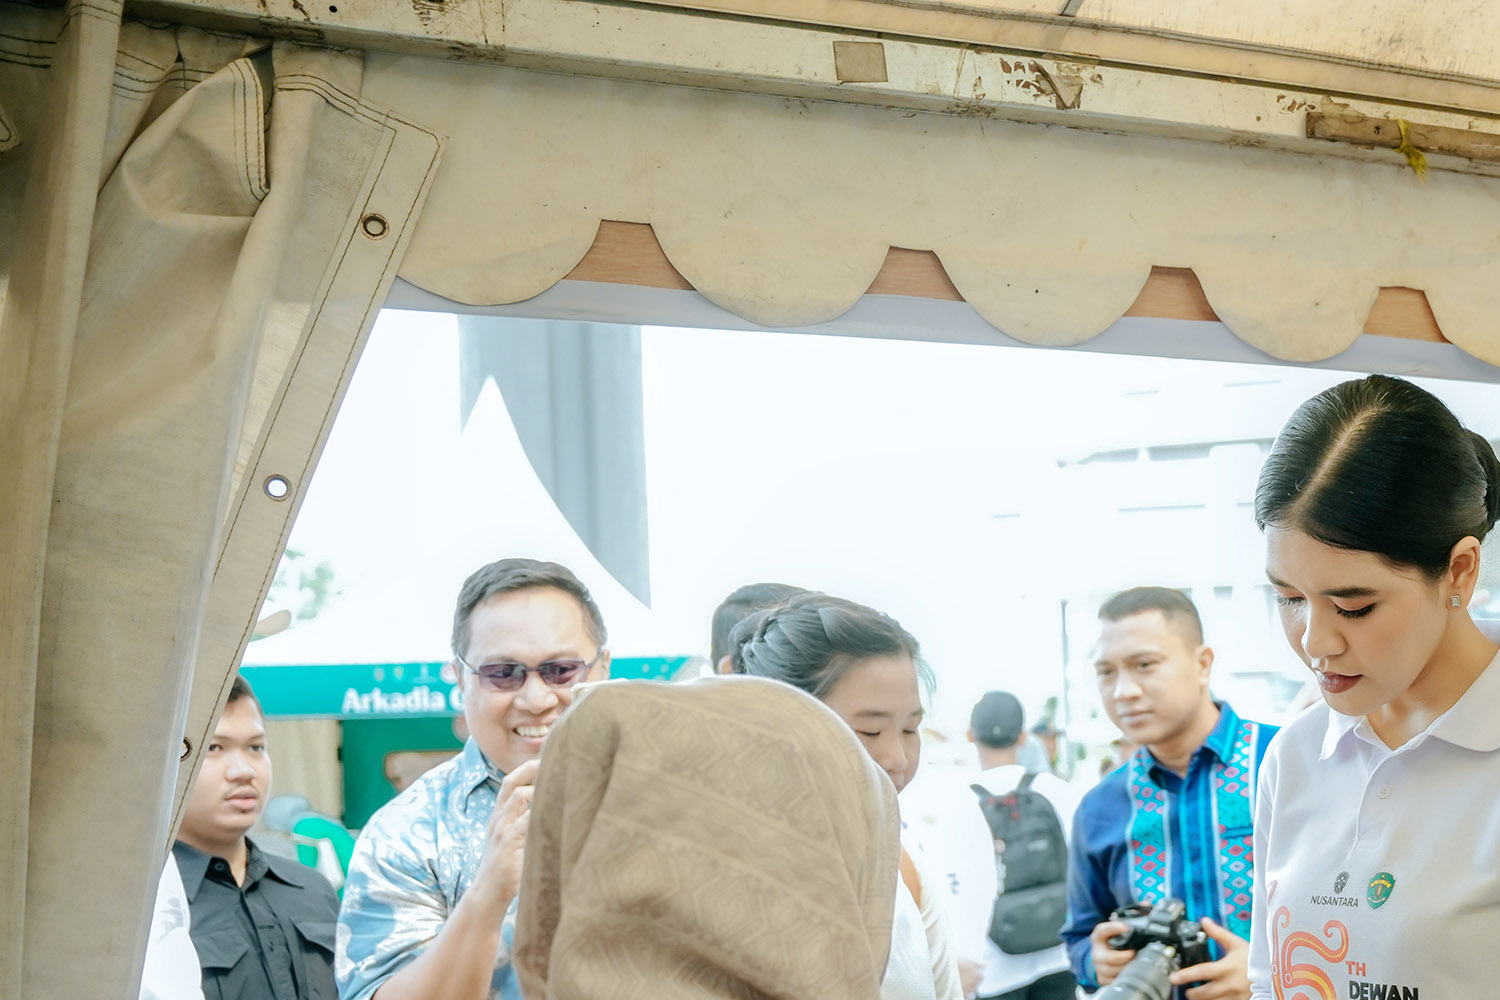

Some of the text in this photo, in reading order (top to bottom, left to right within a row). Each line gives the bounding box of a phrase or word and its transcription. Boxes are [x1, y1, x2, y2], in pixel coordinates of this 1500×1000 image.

[342, 686, 446, 715] Arkadia
[1310, 896, 1358, 907] NUSANTARA
[1345, 960, 1366, 976] TH
